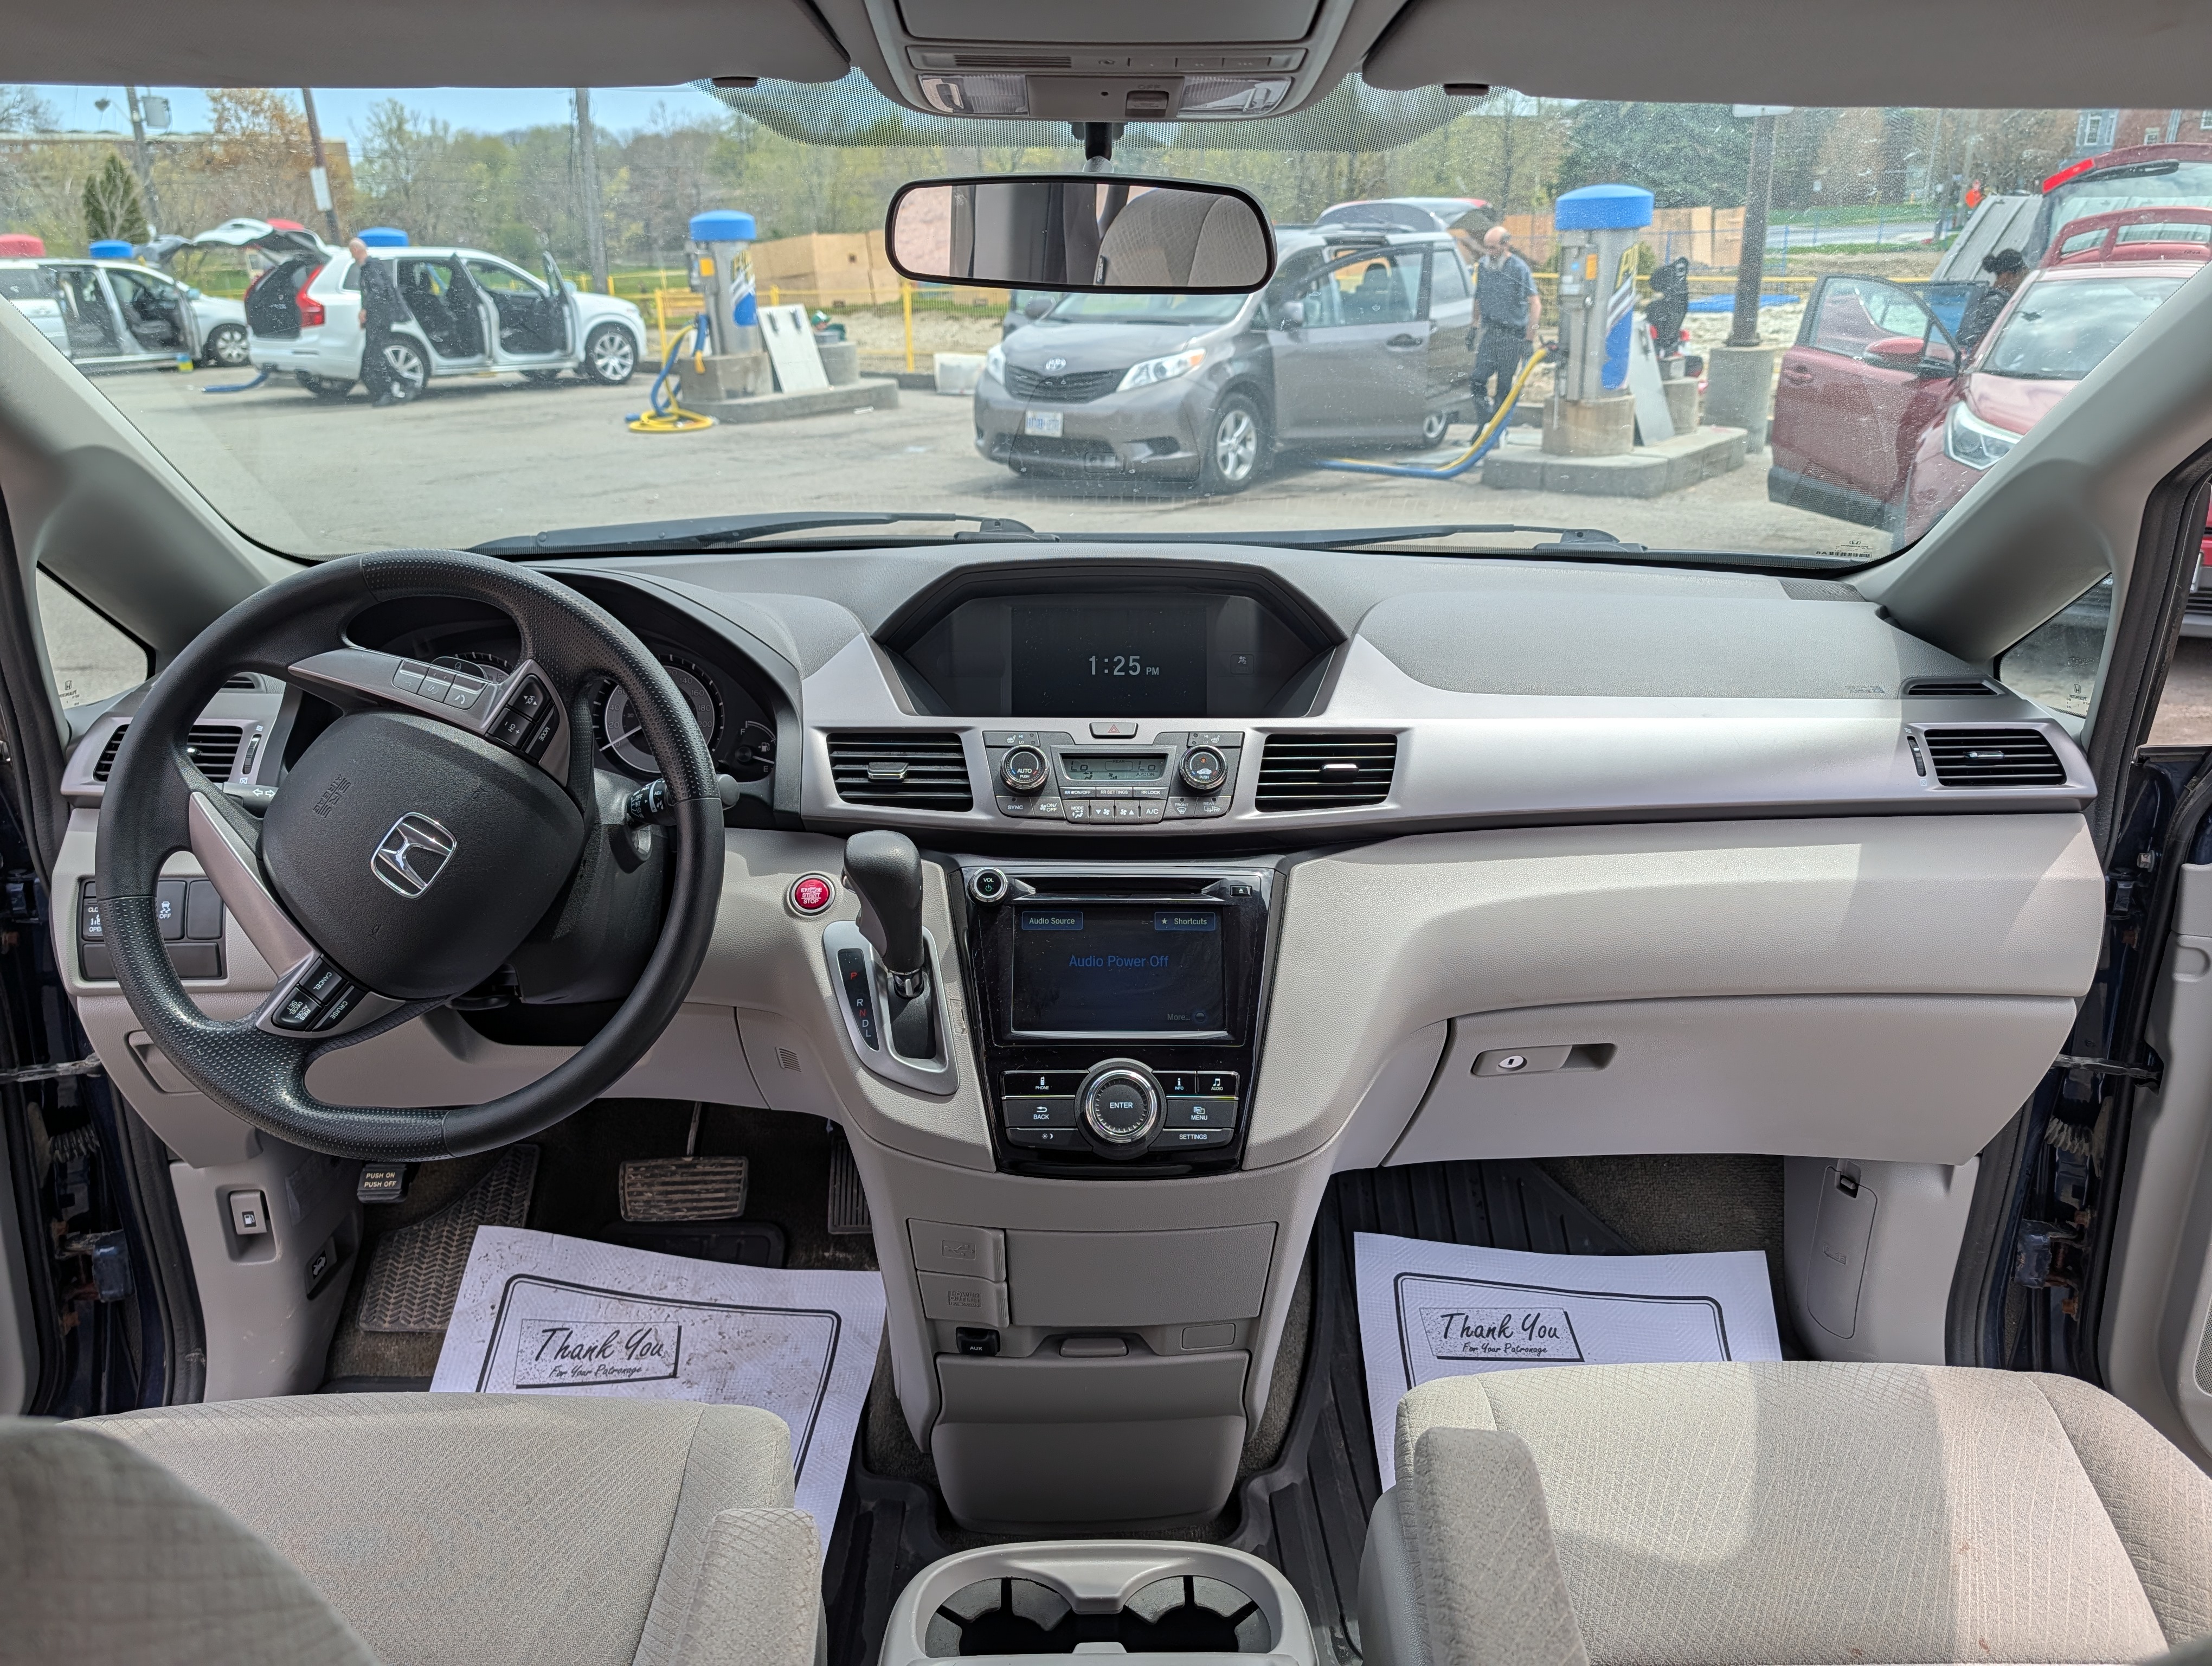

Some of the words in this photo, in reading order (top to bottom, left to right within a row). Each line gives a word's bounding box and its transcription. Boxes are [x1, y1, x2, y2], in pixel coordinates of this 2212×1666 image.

[1089, 656, 1140, 675] 1:25
[1146, 667, 1159, 675] PM
[525, 695, 535, 705] VOL
[507, 723, 516, 733] CH
[538, 726, 550, 742] MODE
[313, 774, 343, 813] AIRBAG
[320, 779, 351, 818] SRS
[1069, 955, 1103, 967] Audio
[1108, 956, 1146, 967] Power
[1149, 955, 1169, 967] Off
[313, 972, 332, 990] CANCEL
[850, 971, 857, 980] P
[287, 1000, 295, 1013] SET
[290, 1001, 303, 1015] DECEL
[857, 998, 863, 1007] R
[294, 1004, 308, 1019] ACCEL
[299, 1008, 311, 1021] RES
[330, 1001, 348, 1020] CRUISE
[859, 1009, 866, 1017] N
[862, 1019, 869, 1028] D
[866, 1029, 871, 1037] L
[1440, 1312, 1514, 1341] Thank
[1521, 1312, 1560, 1341] You
[535, 1327, 621, 1362] Thank
[625, 1327, 664, 1361] You
[1463, 1342, 1478, 1352] For
[1481, 1342, 1501, 1353] Your
[1504, 1342, 1548, 1357] Patronage
[549, 1364, 568, 1378] For
[571, 1364, 592, 1378] Your
[594, 1363, 642, 1378] Patronage
